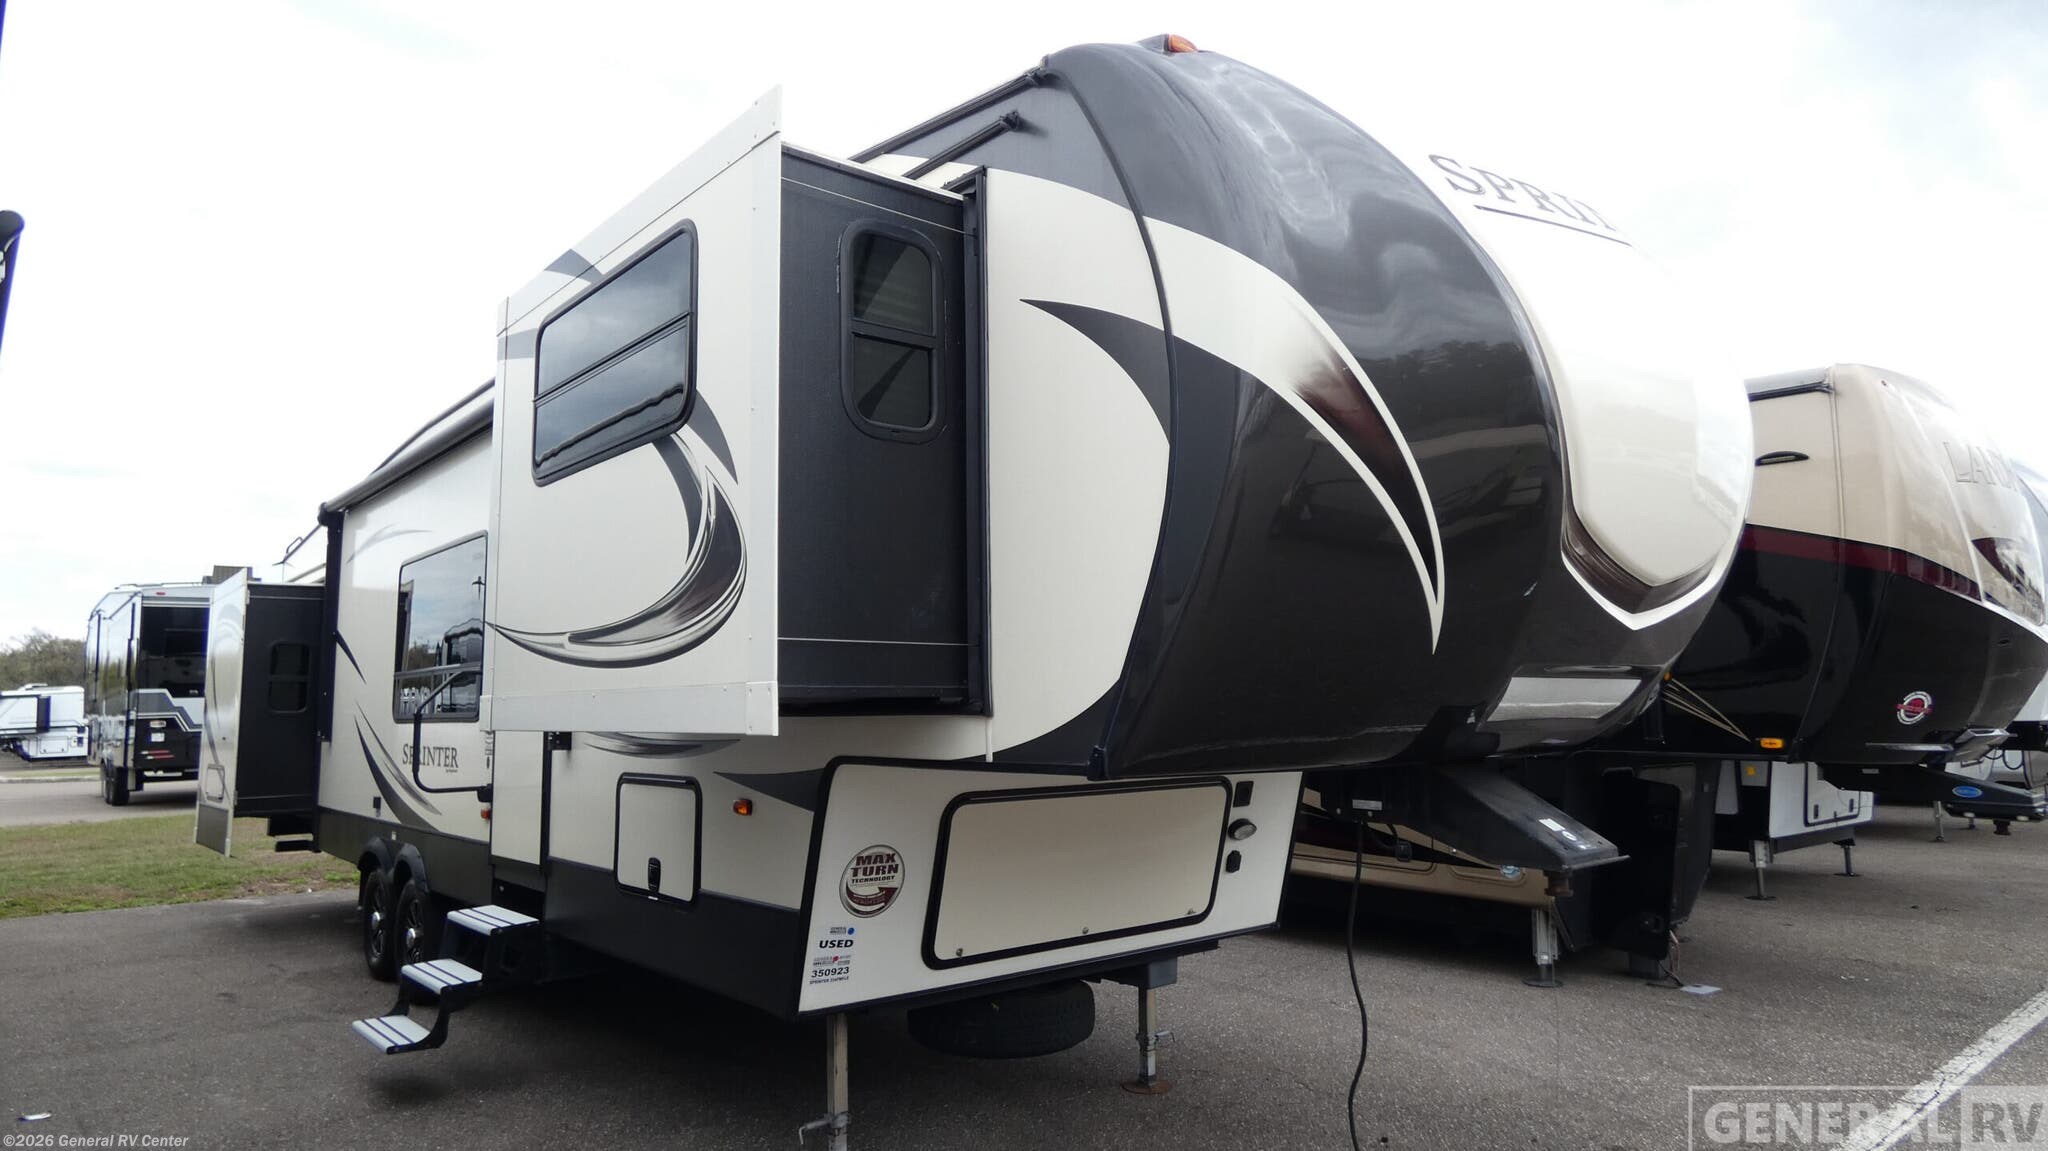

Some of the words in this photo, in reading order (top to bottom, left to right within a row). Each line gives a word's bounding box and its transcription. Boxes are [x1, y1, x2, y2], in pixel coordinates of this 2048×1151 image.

[402, 743, 459, 769] SPINTER
[856, 853, 896, 866] MAX
[850, 864, 899, 877] TURN
[819, 939, 854, 949] USED
[811, 966, 850, 978] 350923
